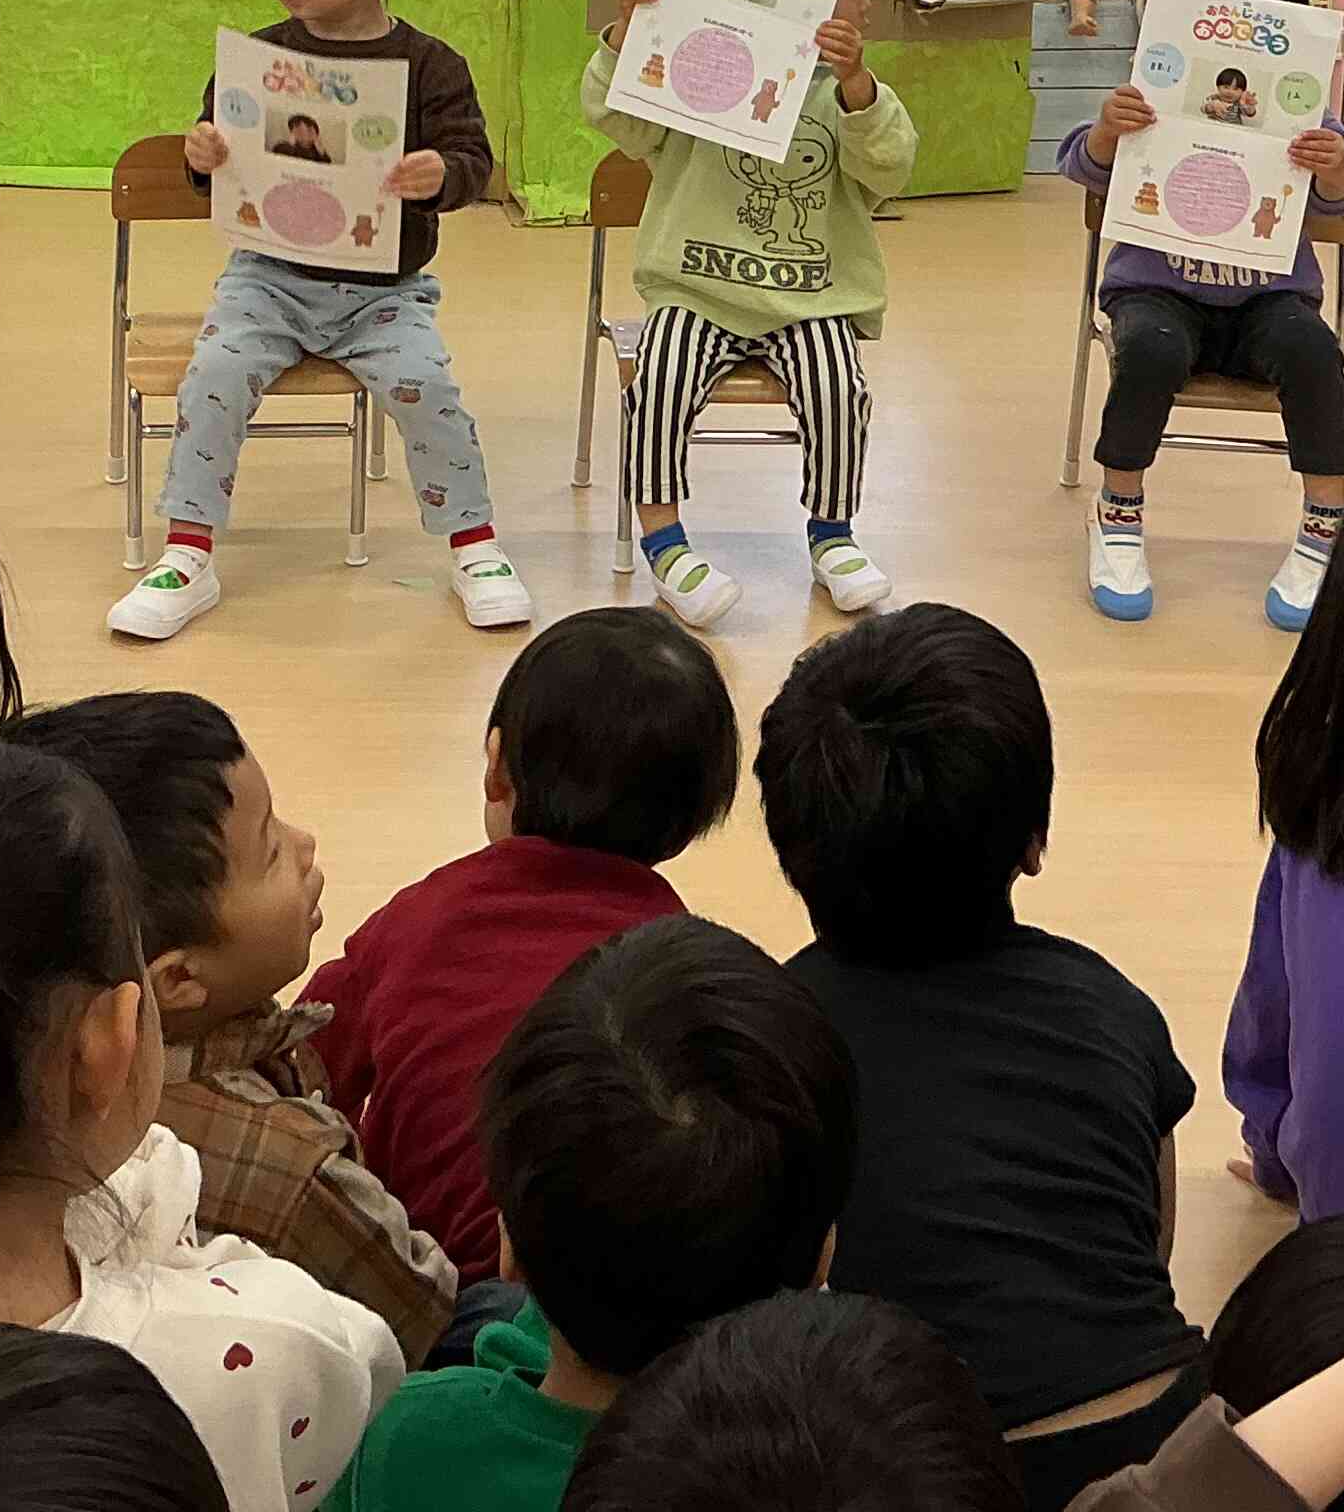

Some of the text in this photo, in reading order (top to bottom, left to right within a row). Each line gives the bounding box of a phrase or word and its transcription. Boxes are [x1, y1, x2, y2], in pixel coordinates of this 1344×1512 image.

[1205, 4, 1287, 29] おたんじょうび
[1192, 18, 1290, 56] おめでとう
